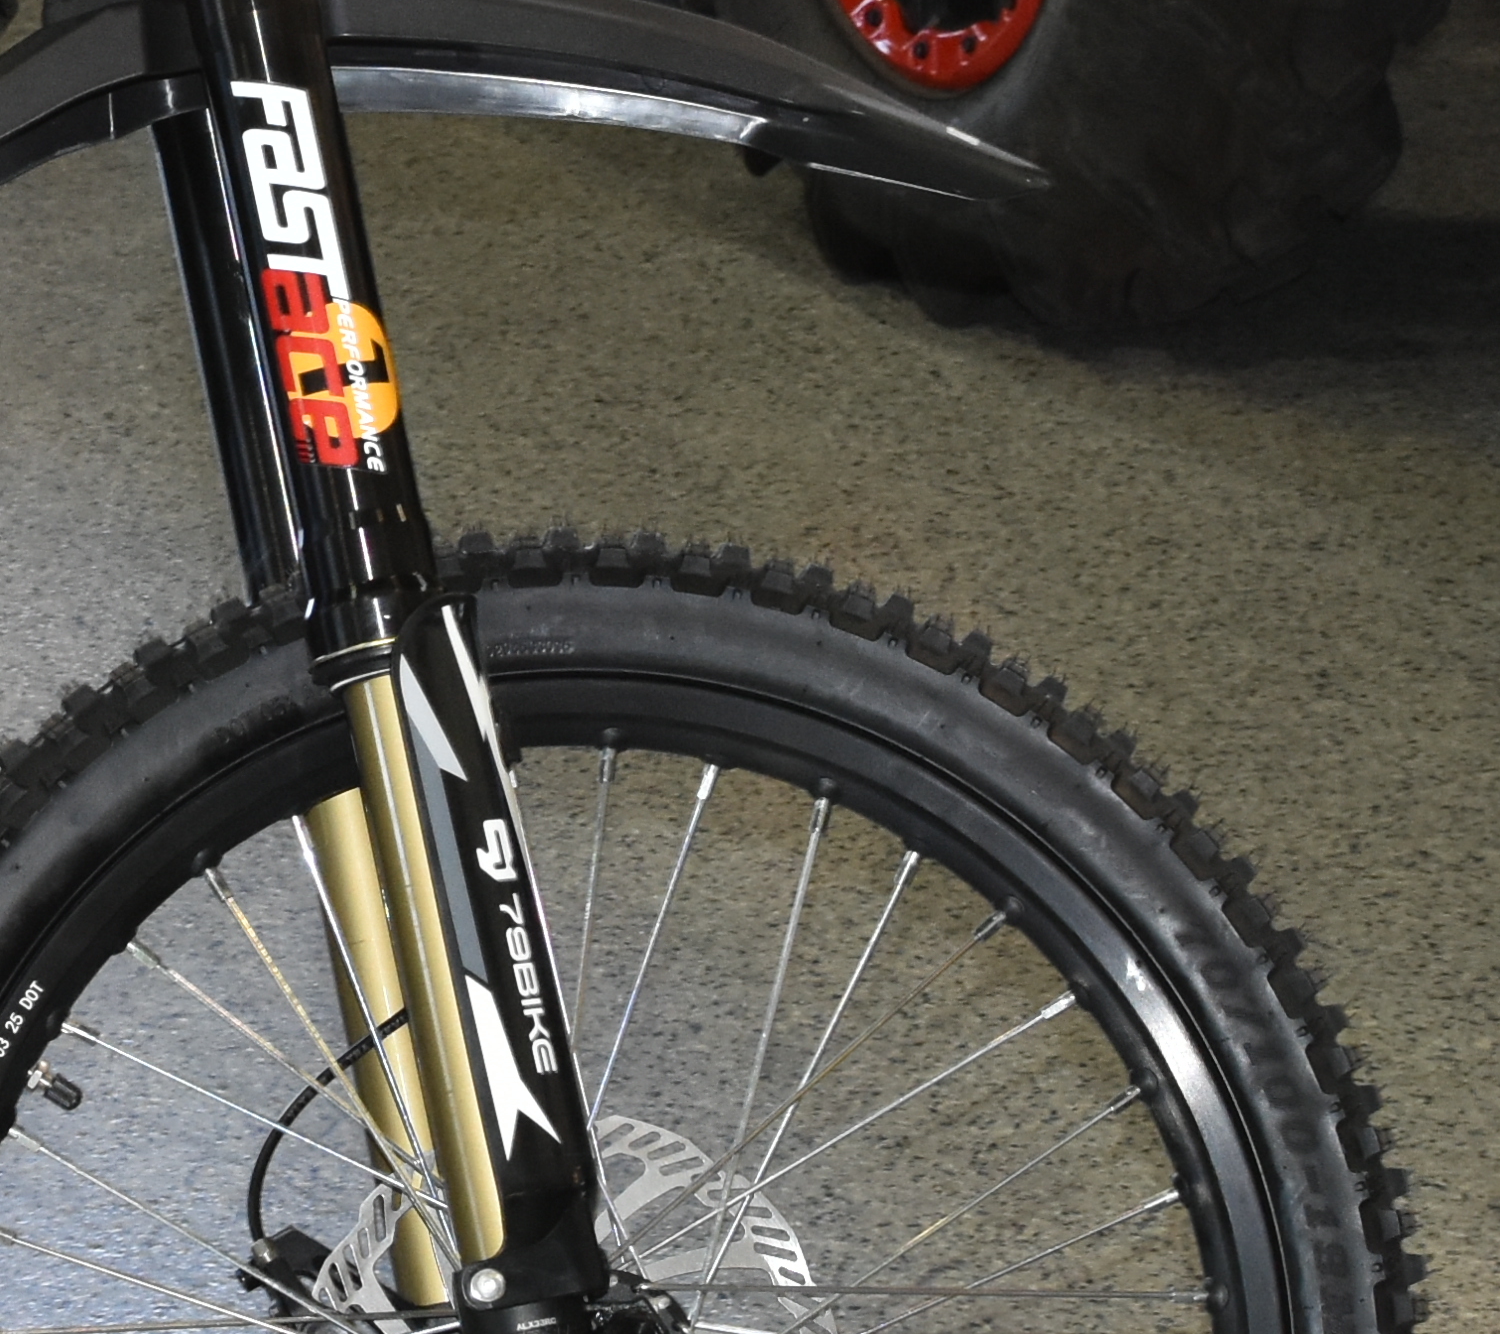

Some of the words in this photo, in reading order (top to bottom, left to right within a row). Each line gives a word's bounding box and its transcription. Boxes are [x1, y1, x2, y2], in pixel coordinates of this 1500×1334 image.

[332, 297, 387, 475] PERFORMANCE
[4, 1012, 24, 1034] 25
[18, 980, 44, 1011] DOT
[499, 893, 558, 1075] 79BIKE
